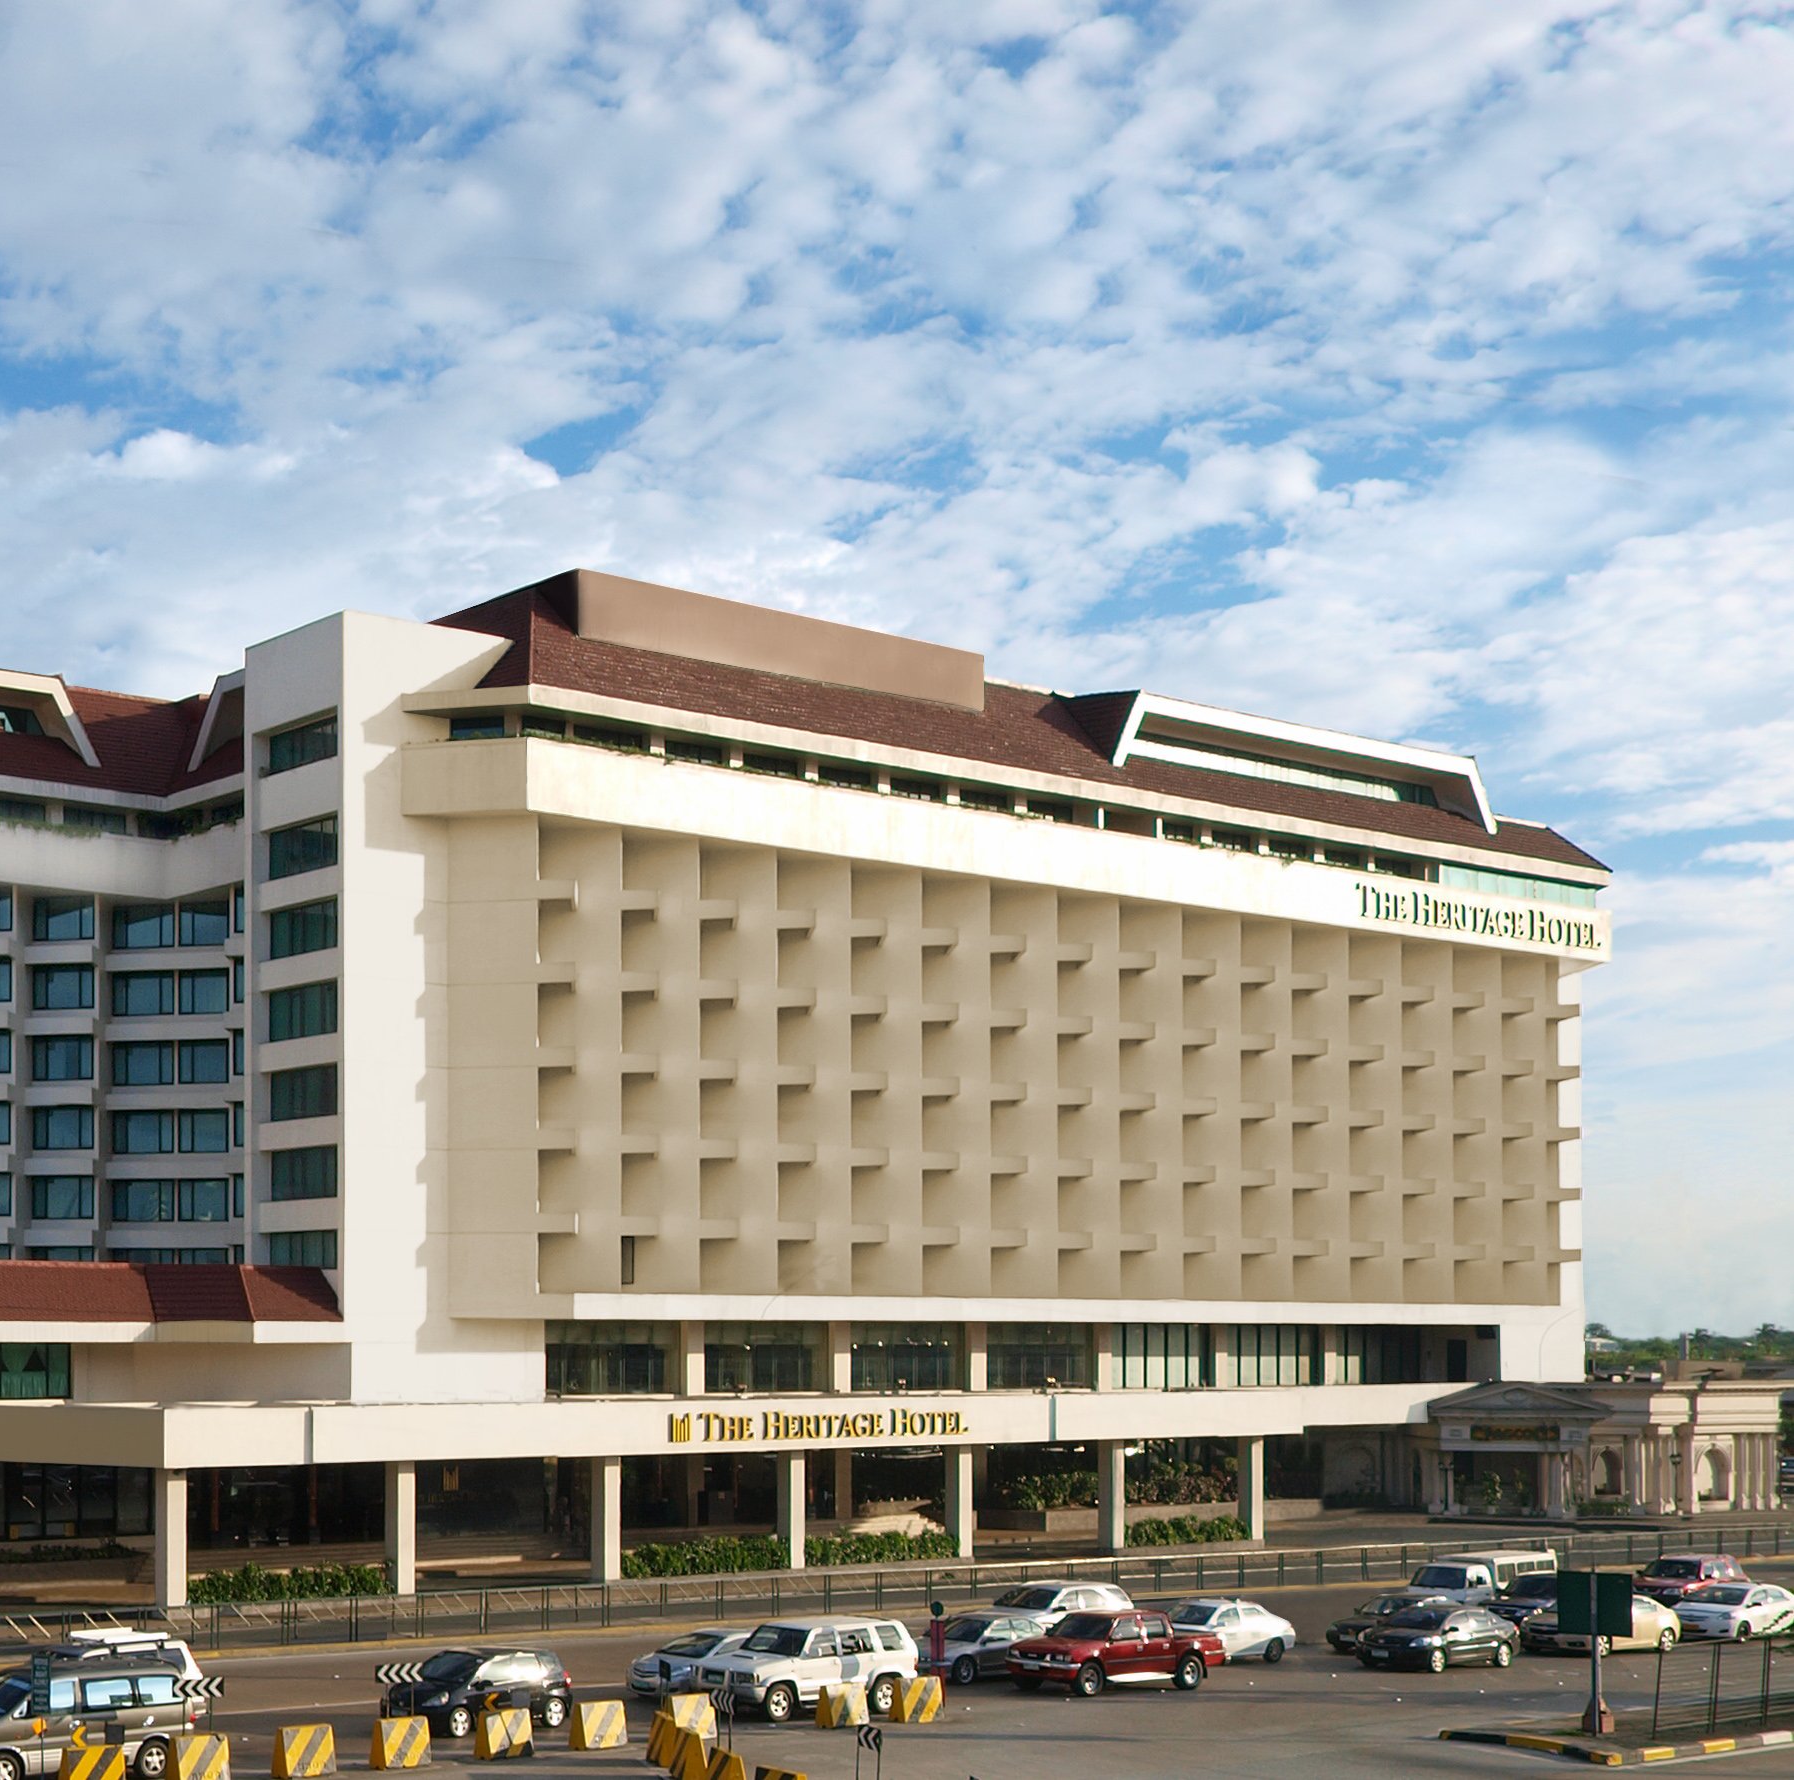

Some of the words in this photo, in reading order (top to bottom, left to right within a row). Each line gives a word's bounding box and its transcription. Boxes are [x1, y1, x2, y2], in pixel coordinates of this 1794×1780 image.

[1355, 882, 1408, 921] THE
[1411, 890, 1525, 940] HERITAGE
[1527, 909, 1602, 950] HOTEL
[696, 1412, 755, 1442] THE
[762, 1410, 884, 1441] HERITAGE
[889, 1407, 969, 1437] HOTEL
